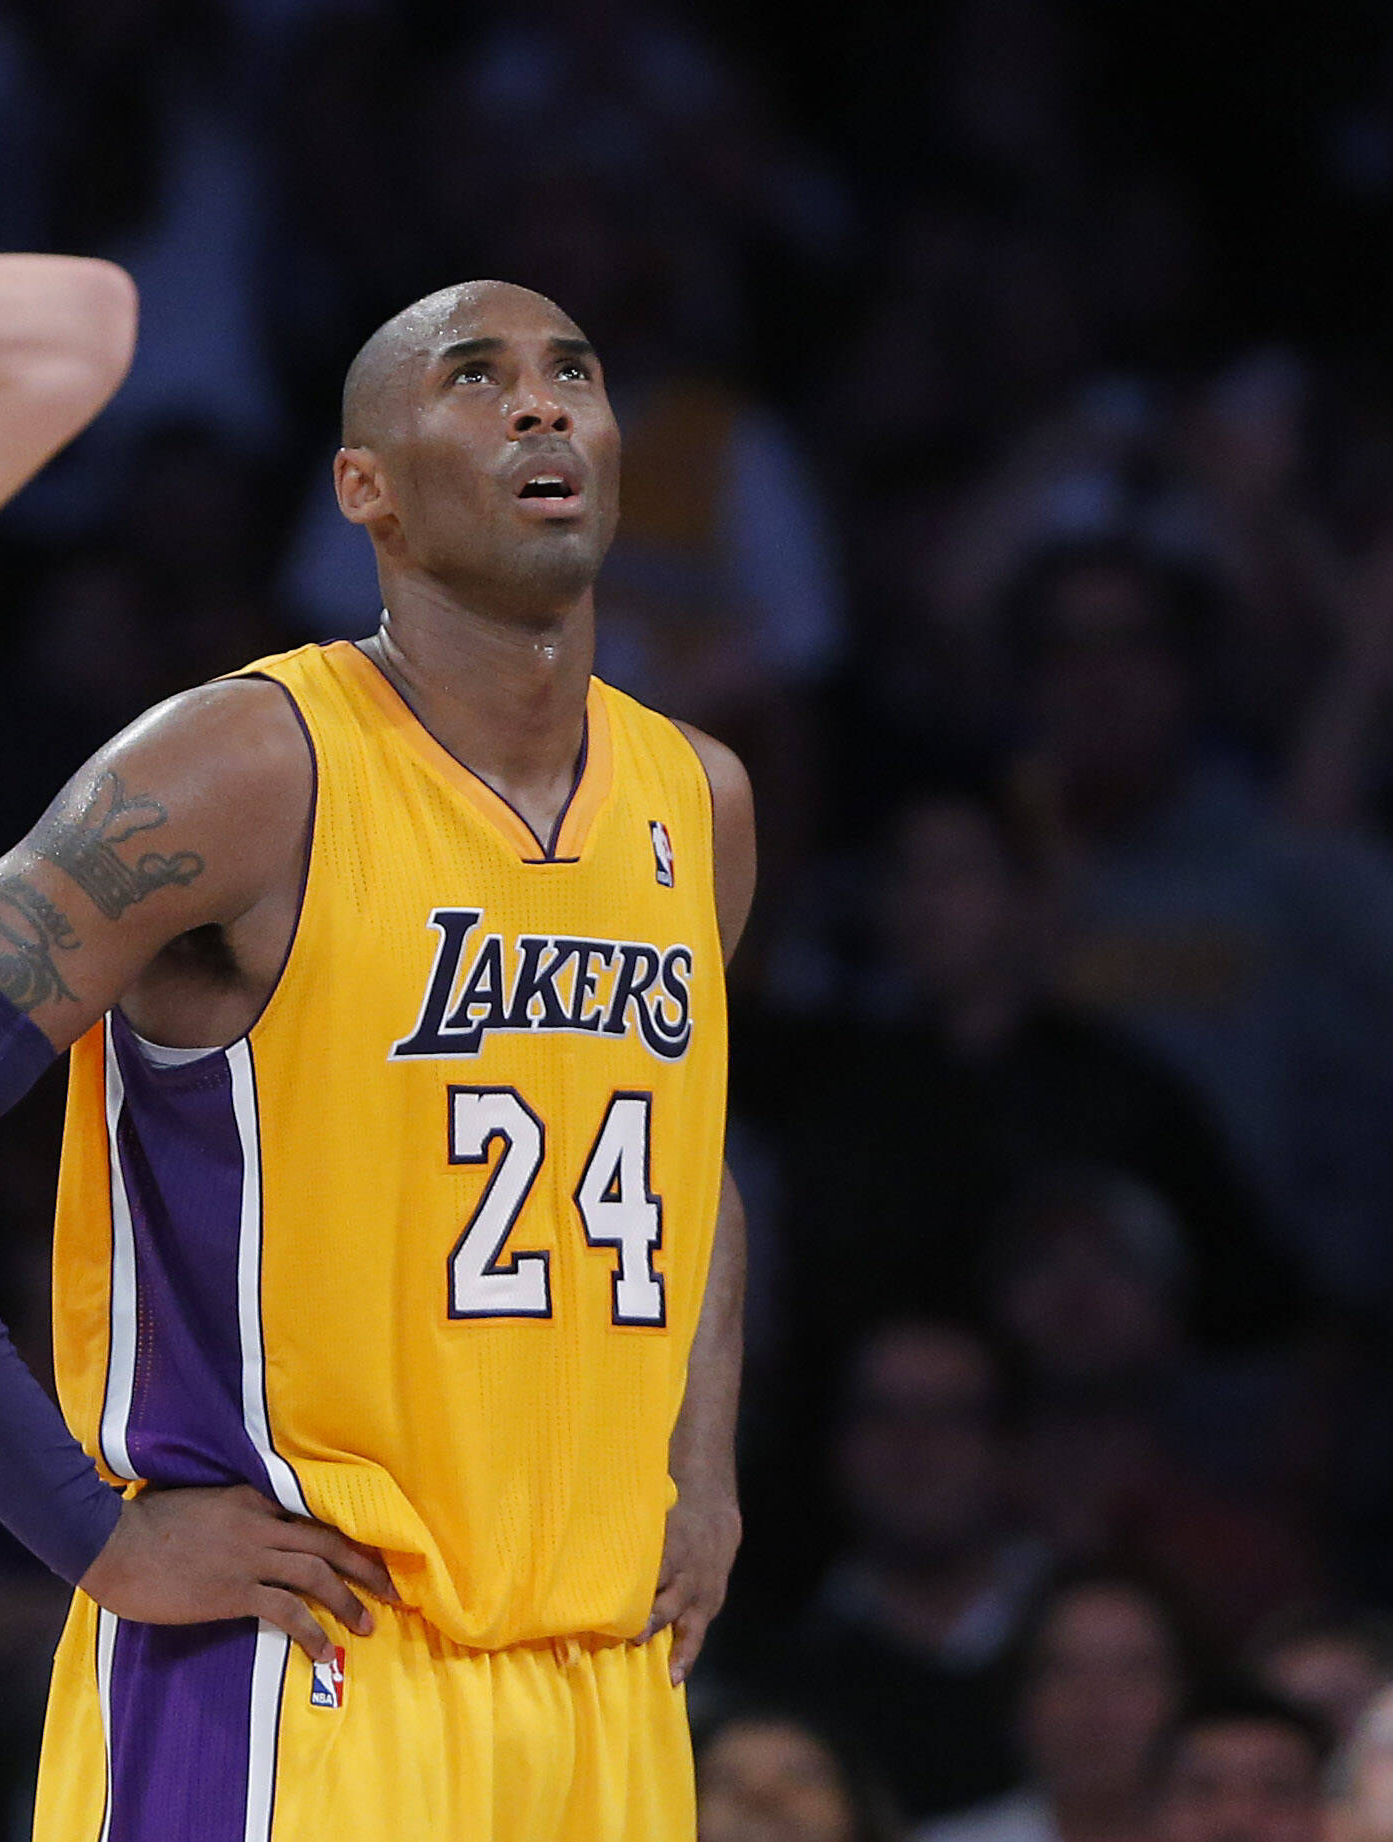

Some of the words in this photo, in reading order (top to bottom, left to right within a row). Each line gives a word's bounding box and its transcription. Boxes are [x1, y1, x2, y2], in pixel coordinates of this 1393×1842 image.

[387, 906, 694, 1062] LAKERS
[447, 1084, 667, 1327] 24
[312, 1692, 333, 1704] NBA
